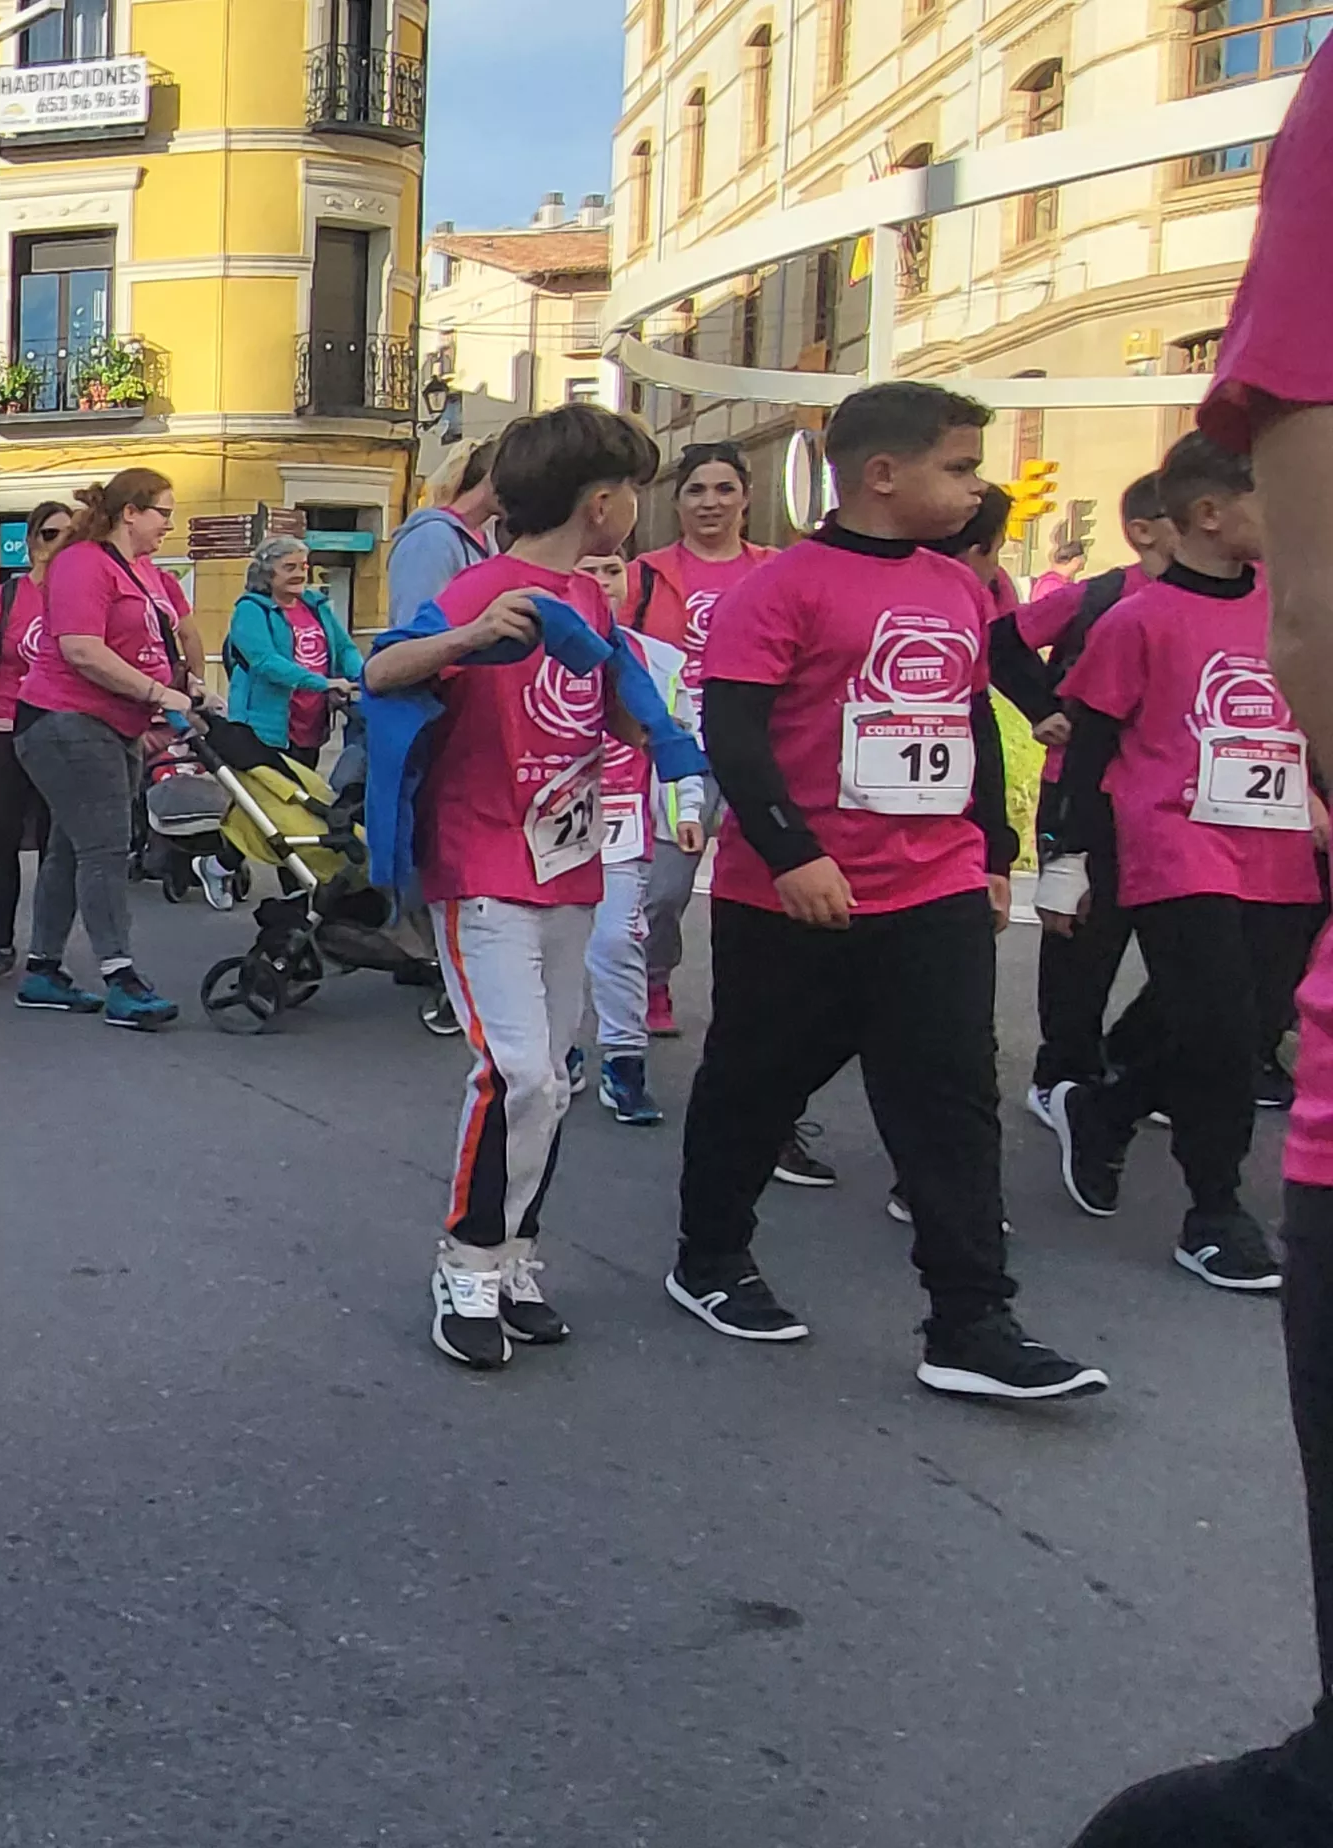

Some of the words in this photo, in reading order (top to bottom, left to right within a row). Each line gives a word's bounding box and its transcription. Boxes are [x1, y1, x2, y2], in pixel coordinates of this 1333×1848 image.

[1, 64, 141, 95] HABITACIONES
[36, 95, 68, 114] 653
[898, 743, 950, 782] 19
[1245, 764, 1286, 801] 20
